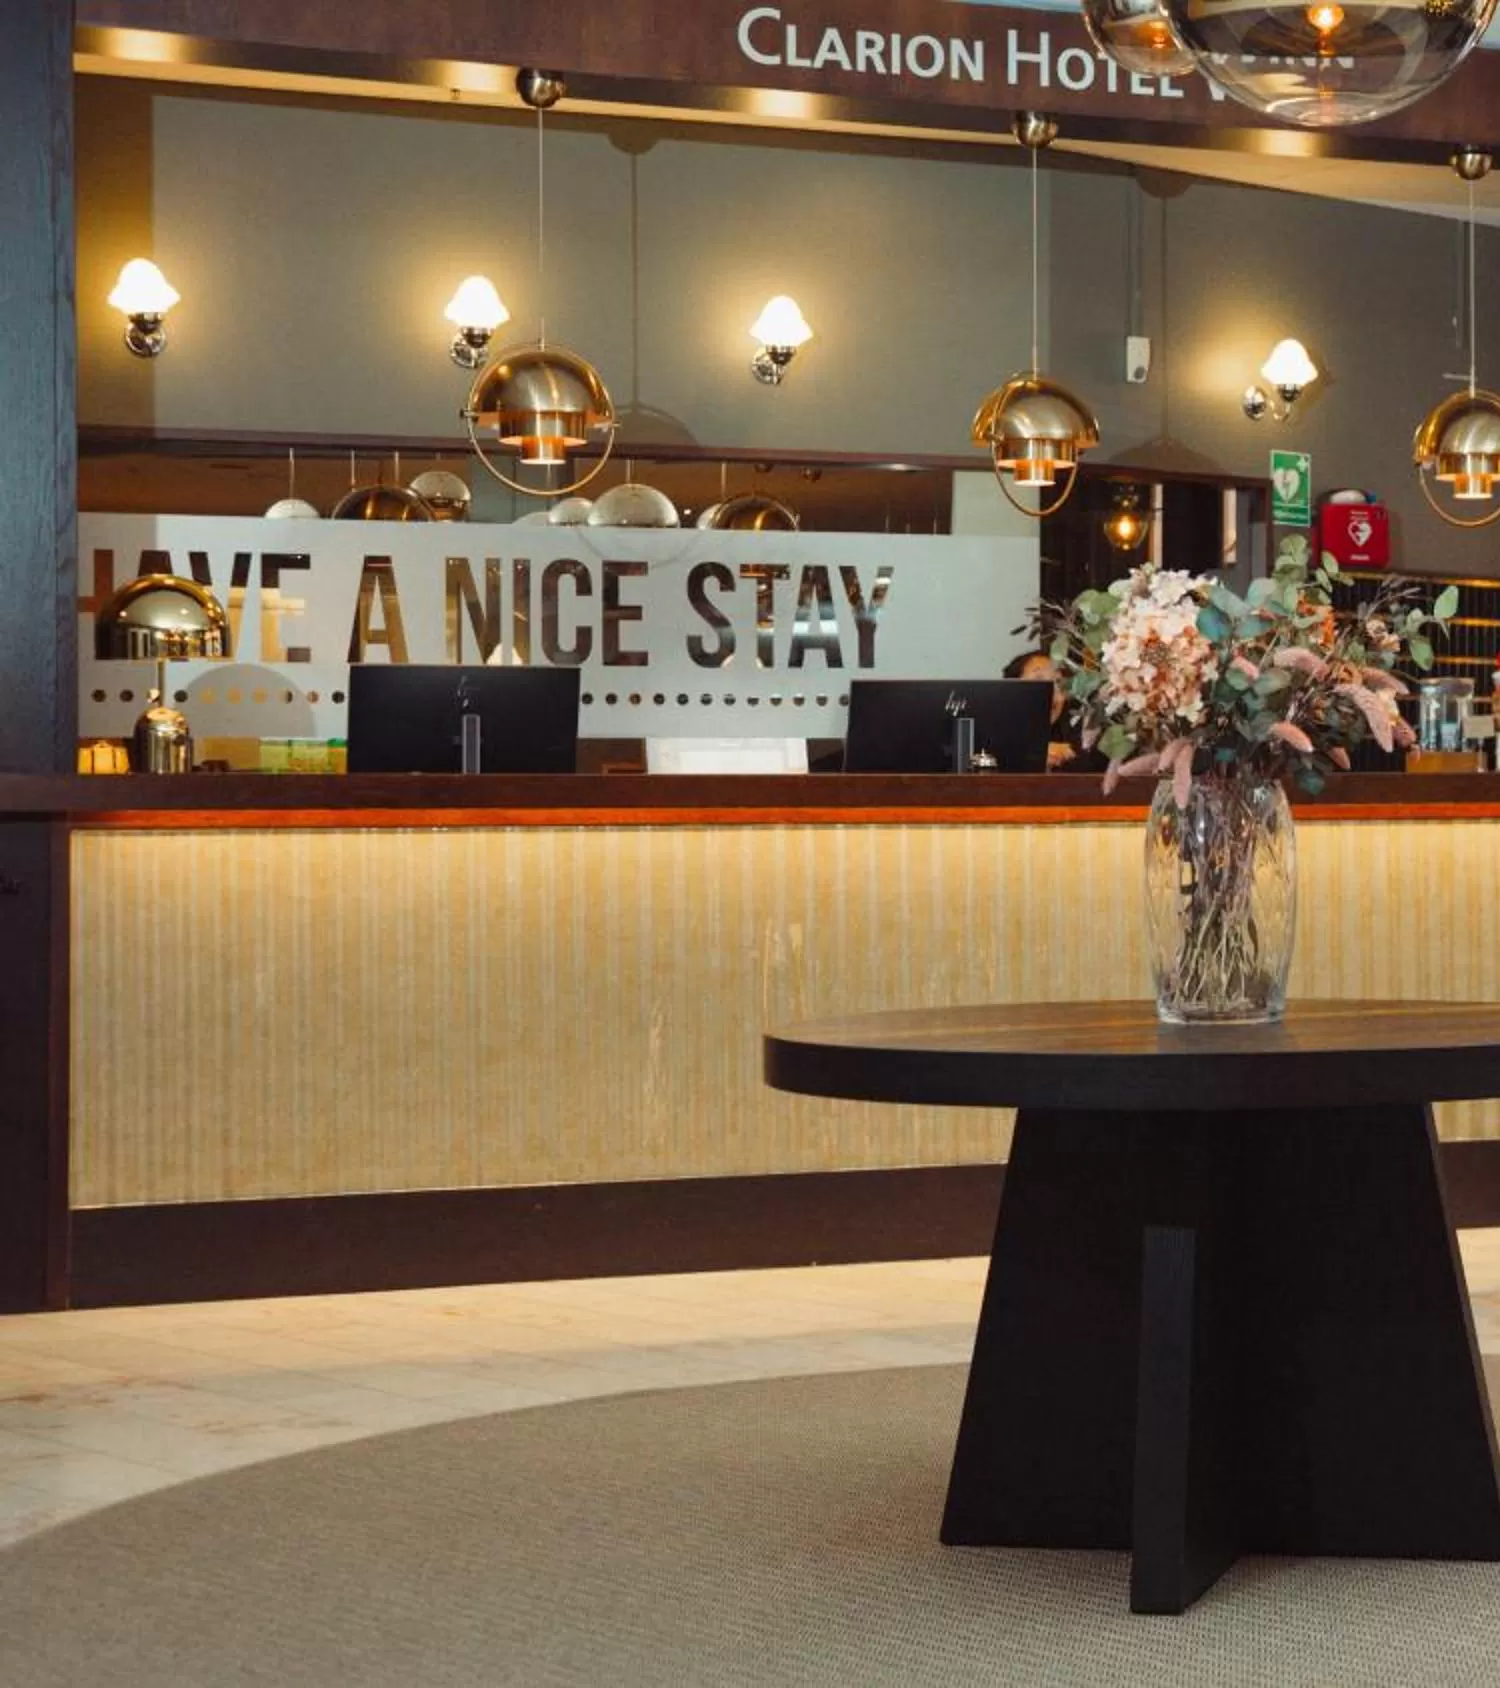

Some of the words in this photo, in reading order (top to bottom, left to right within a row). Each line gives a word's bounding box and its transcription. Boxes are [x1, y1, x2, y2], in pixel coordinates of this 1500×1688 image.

[737, 7, 985, 82] CLARION
[78, 549, 311, 662] VE
[347, 555, 409, 663] A
[445, 557, 649, 666] NICE
[686, 561, 895, 669] STAY
